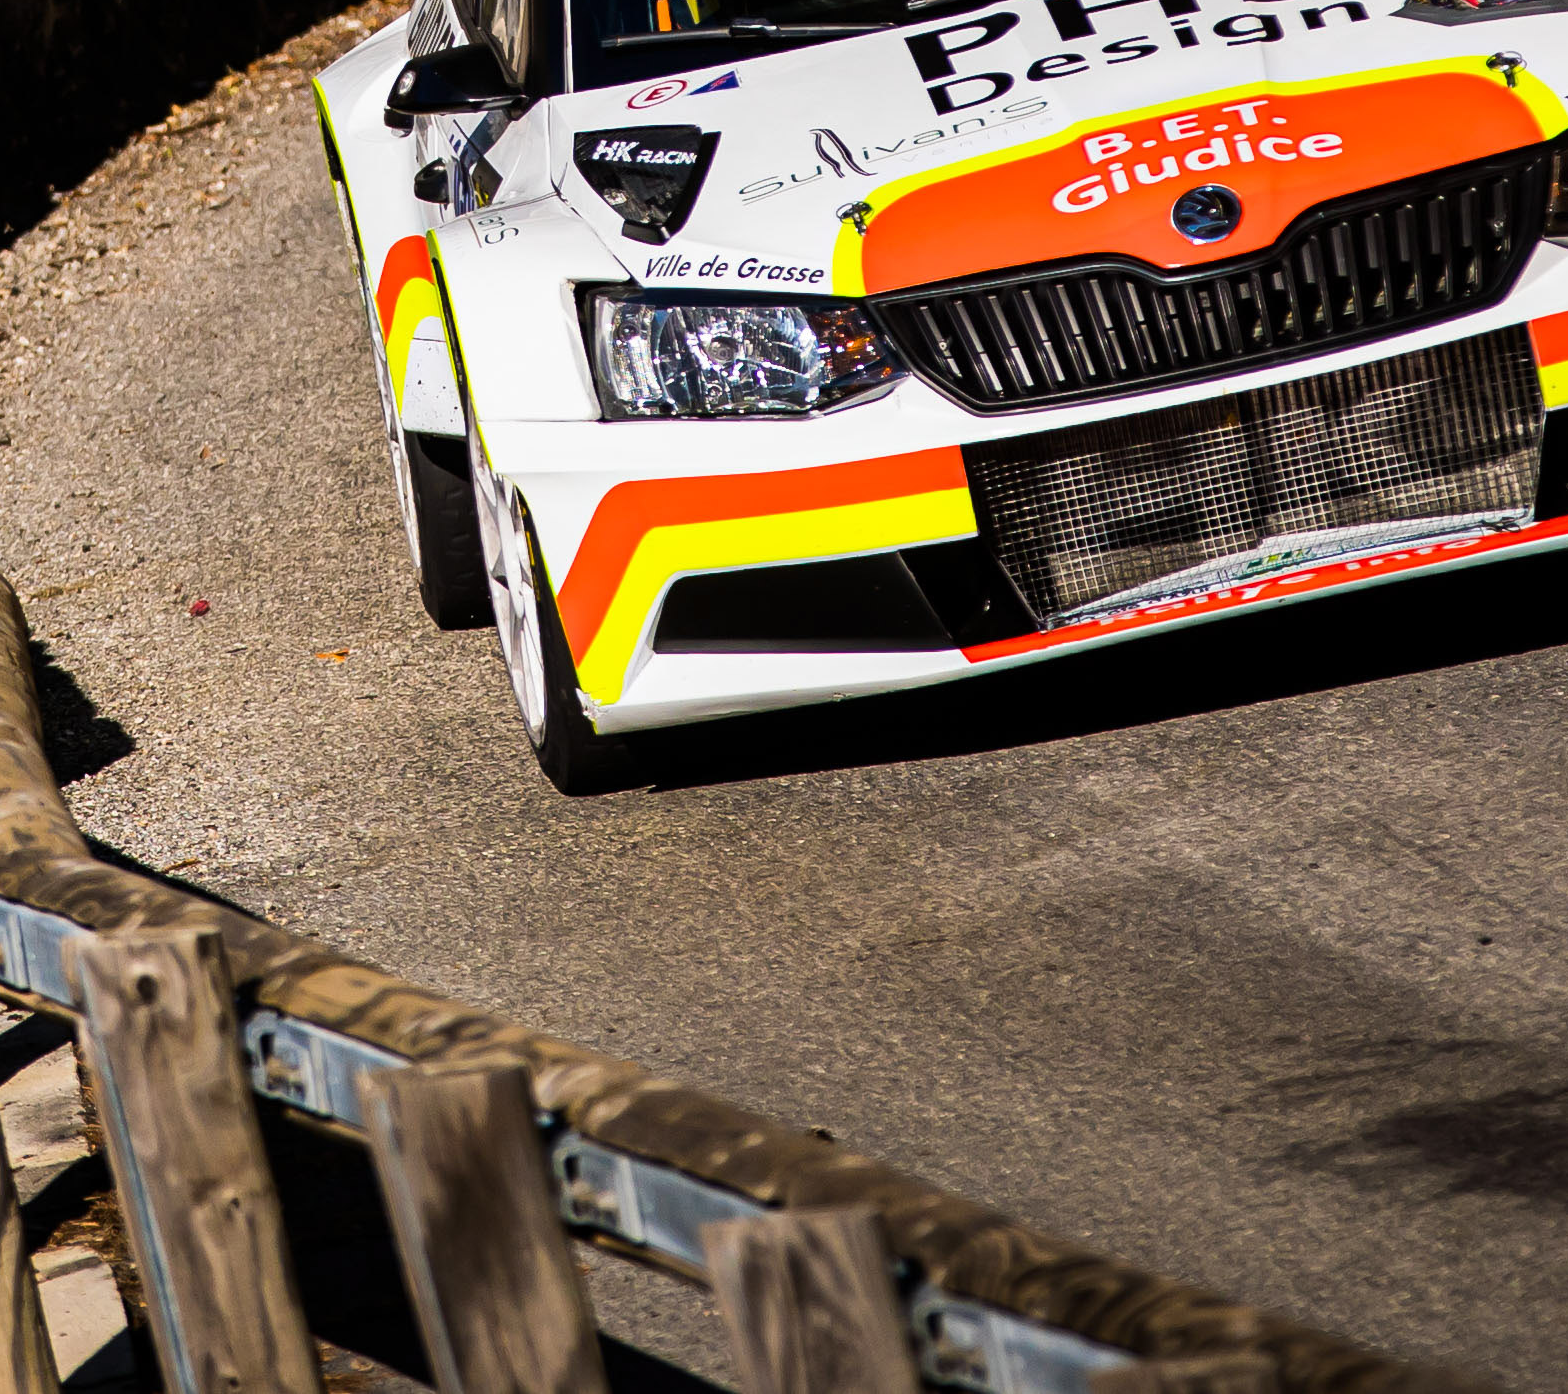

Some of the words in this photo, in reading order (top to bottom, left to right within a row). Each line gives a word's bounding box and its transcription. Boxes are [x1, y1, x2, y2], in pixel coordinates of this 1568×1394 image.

[927, 0, 1370, 116] Design
[591, 140, 637, 163] HK
[1084, 99, 1287, 165] B.E.T.
[1052, 132, 1343, 214] Giudice
[645, 256, 692, 278] Ville
[698, 256, 728, 278] de
[736, 257, 825, 285] Grasse
